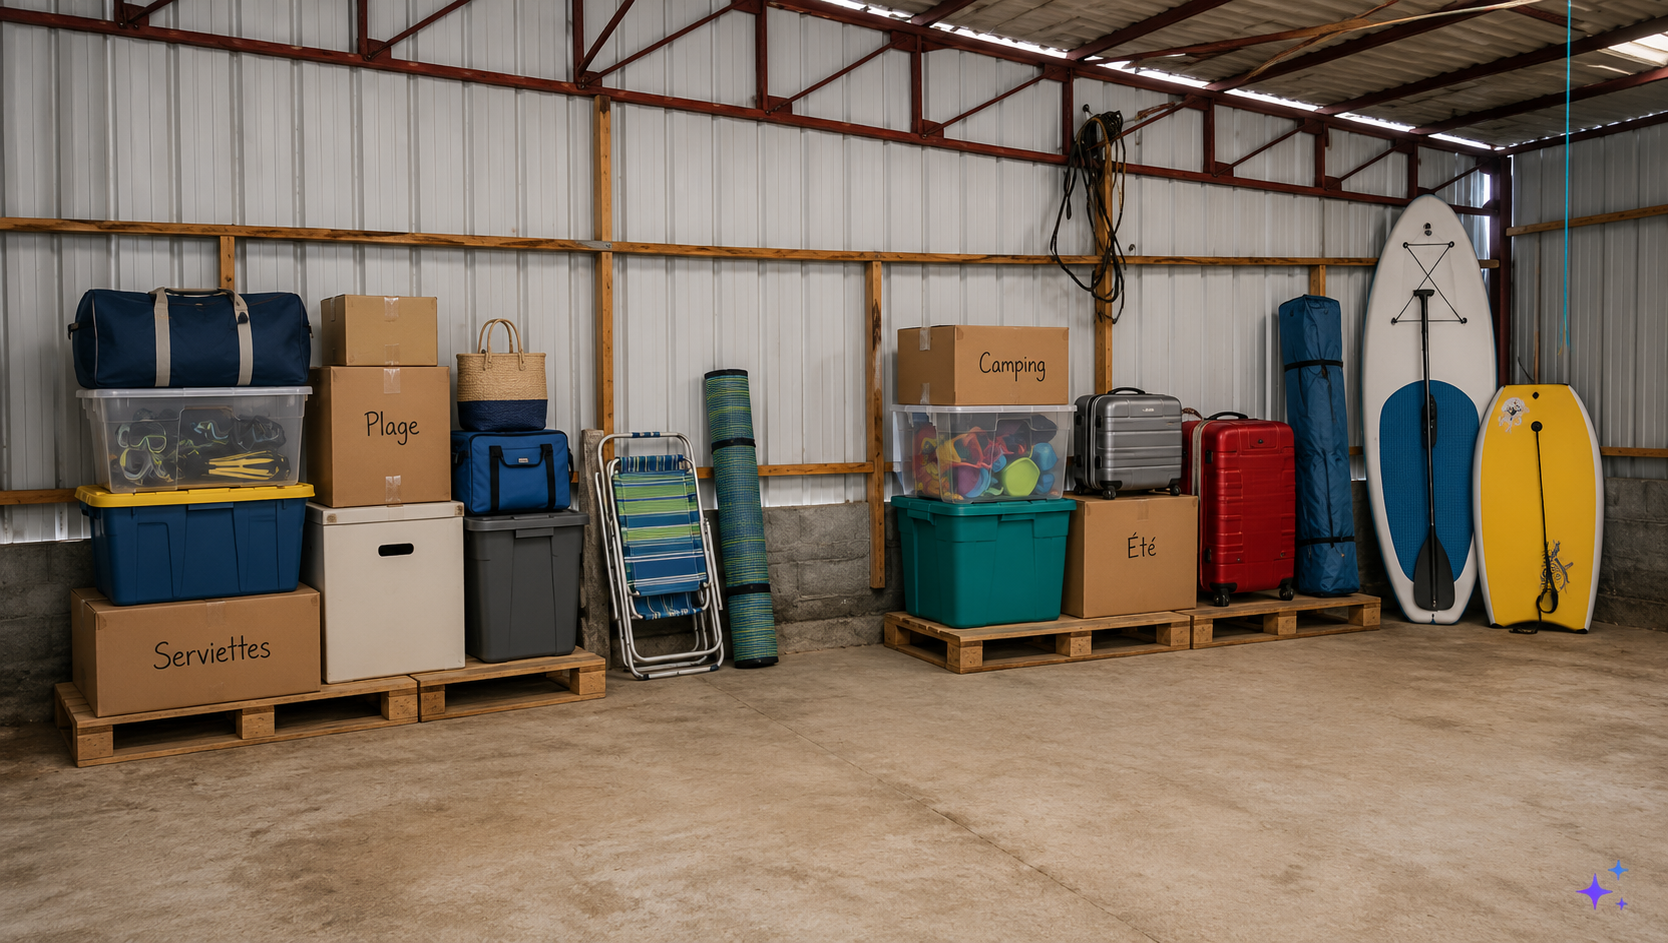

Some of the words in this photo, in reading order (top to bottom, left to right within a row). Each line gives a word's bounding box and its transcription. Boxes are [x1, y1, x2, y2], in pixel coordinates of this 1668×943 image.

[979, 351, 1046, 382] Camping
[364, 410, 420, 446] Plage
[1127, 531, 1157, 559] Été
[153, 634, 271, 670] Serviettes
